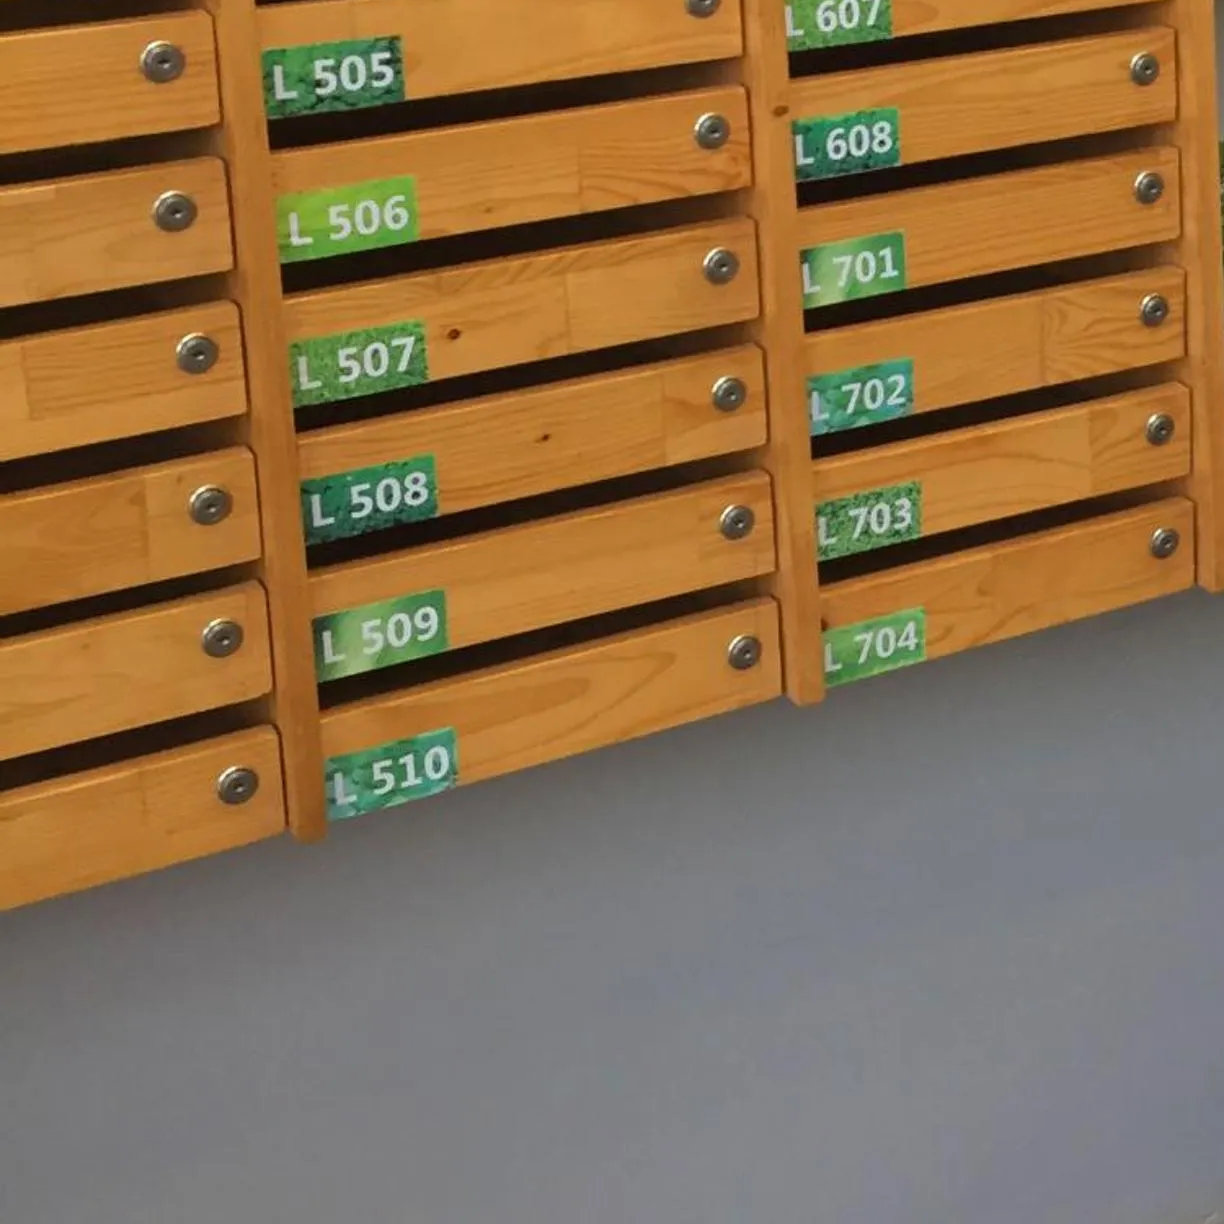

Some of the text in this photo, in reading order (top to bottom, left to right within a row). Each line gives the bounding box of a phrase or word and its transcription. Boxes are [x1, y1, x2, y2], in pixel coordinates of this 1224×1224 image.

[785, 6, 804, 37] L
[274, 52, 394, 100] L 505
[796, 121, 892, 166] L 608
[289, 195, 409, 246] L 506
[804, 246, 899, 294] L 701
[298, 336, 415, 390] L 507
[811, 374, 906, 422] L 702
[312, 472, 429, 527] L 508
[819, 498, 913, 547] L 703
[323, 605, 440, 663] L 509
[826, 621, 918, 673] L 704
[335, 746, 450, 806] L 510
